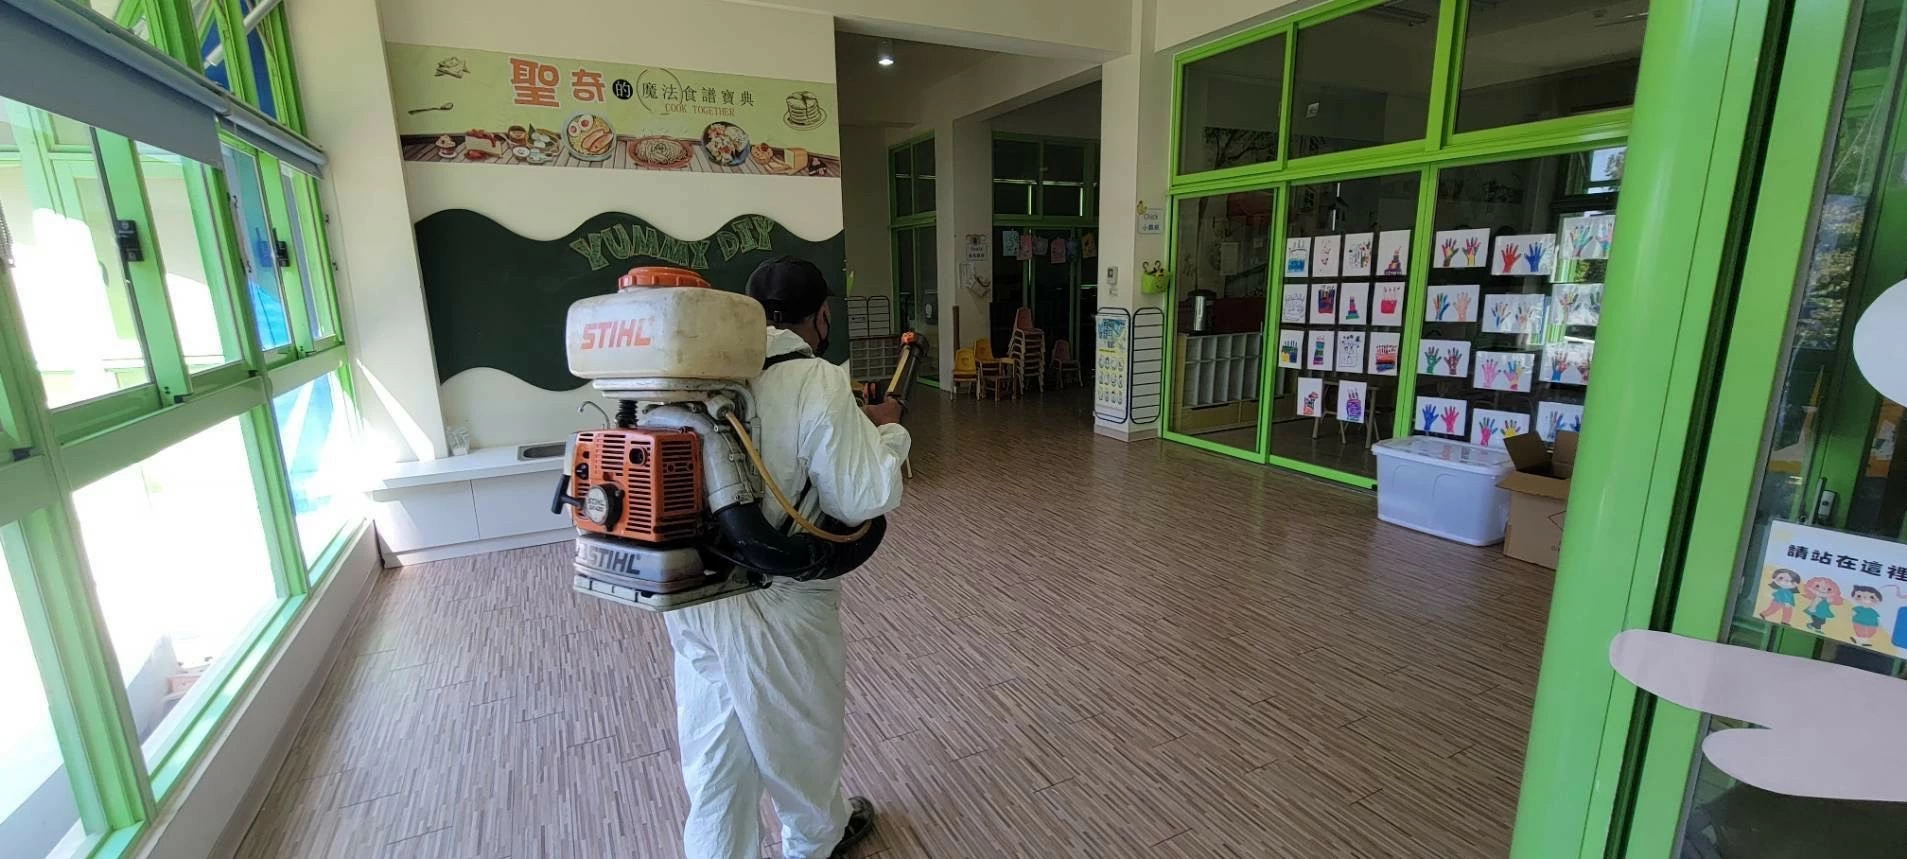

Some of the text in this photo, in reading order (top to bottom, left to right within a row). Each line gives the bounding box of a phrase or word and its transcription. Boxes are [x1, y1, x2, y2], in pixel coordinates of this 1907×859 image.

[664, 102, 735, 117] COOK TOGETHER
[569, 214, 775, 271] YUMMY DIY
[580, 318, 652, 350] STIHL
[588, 545, 641, 575] STIHL
[1787, 544, 1907, 582] 請站在這裡
